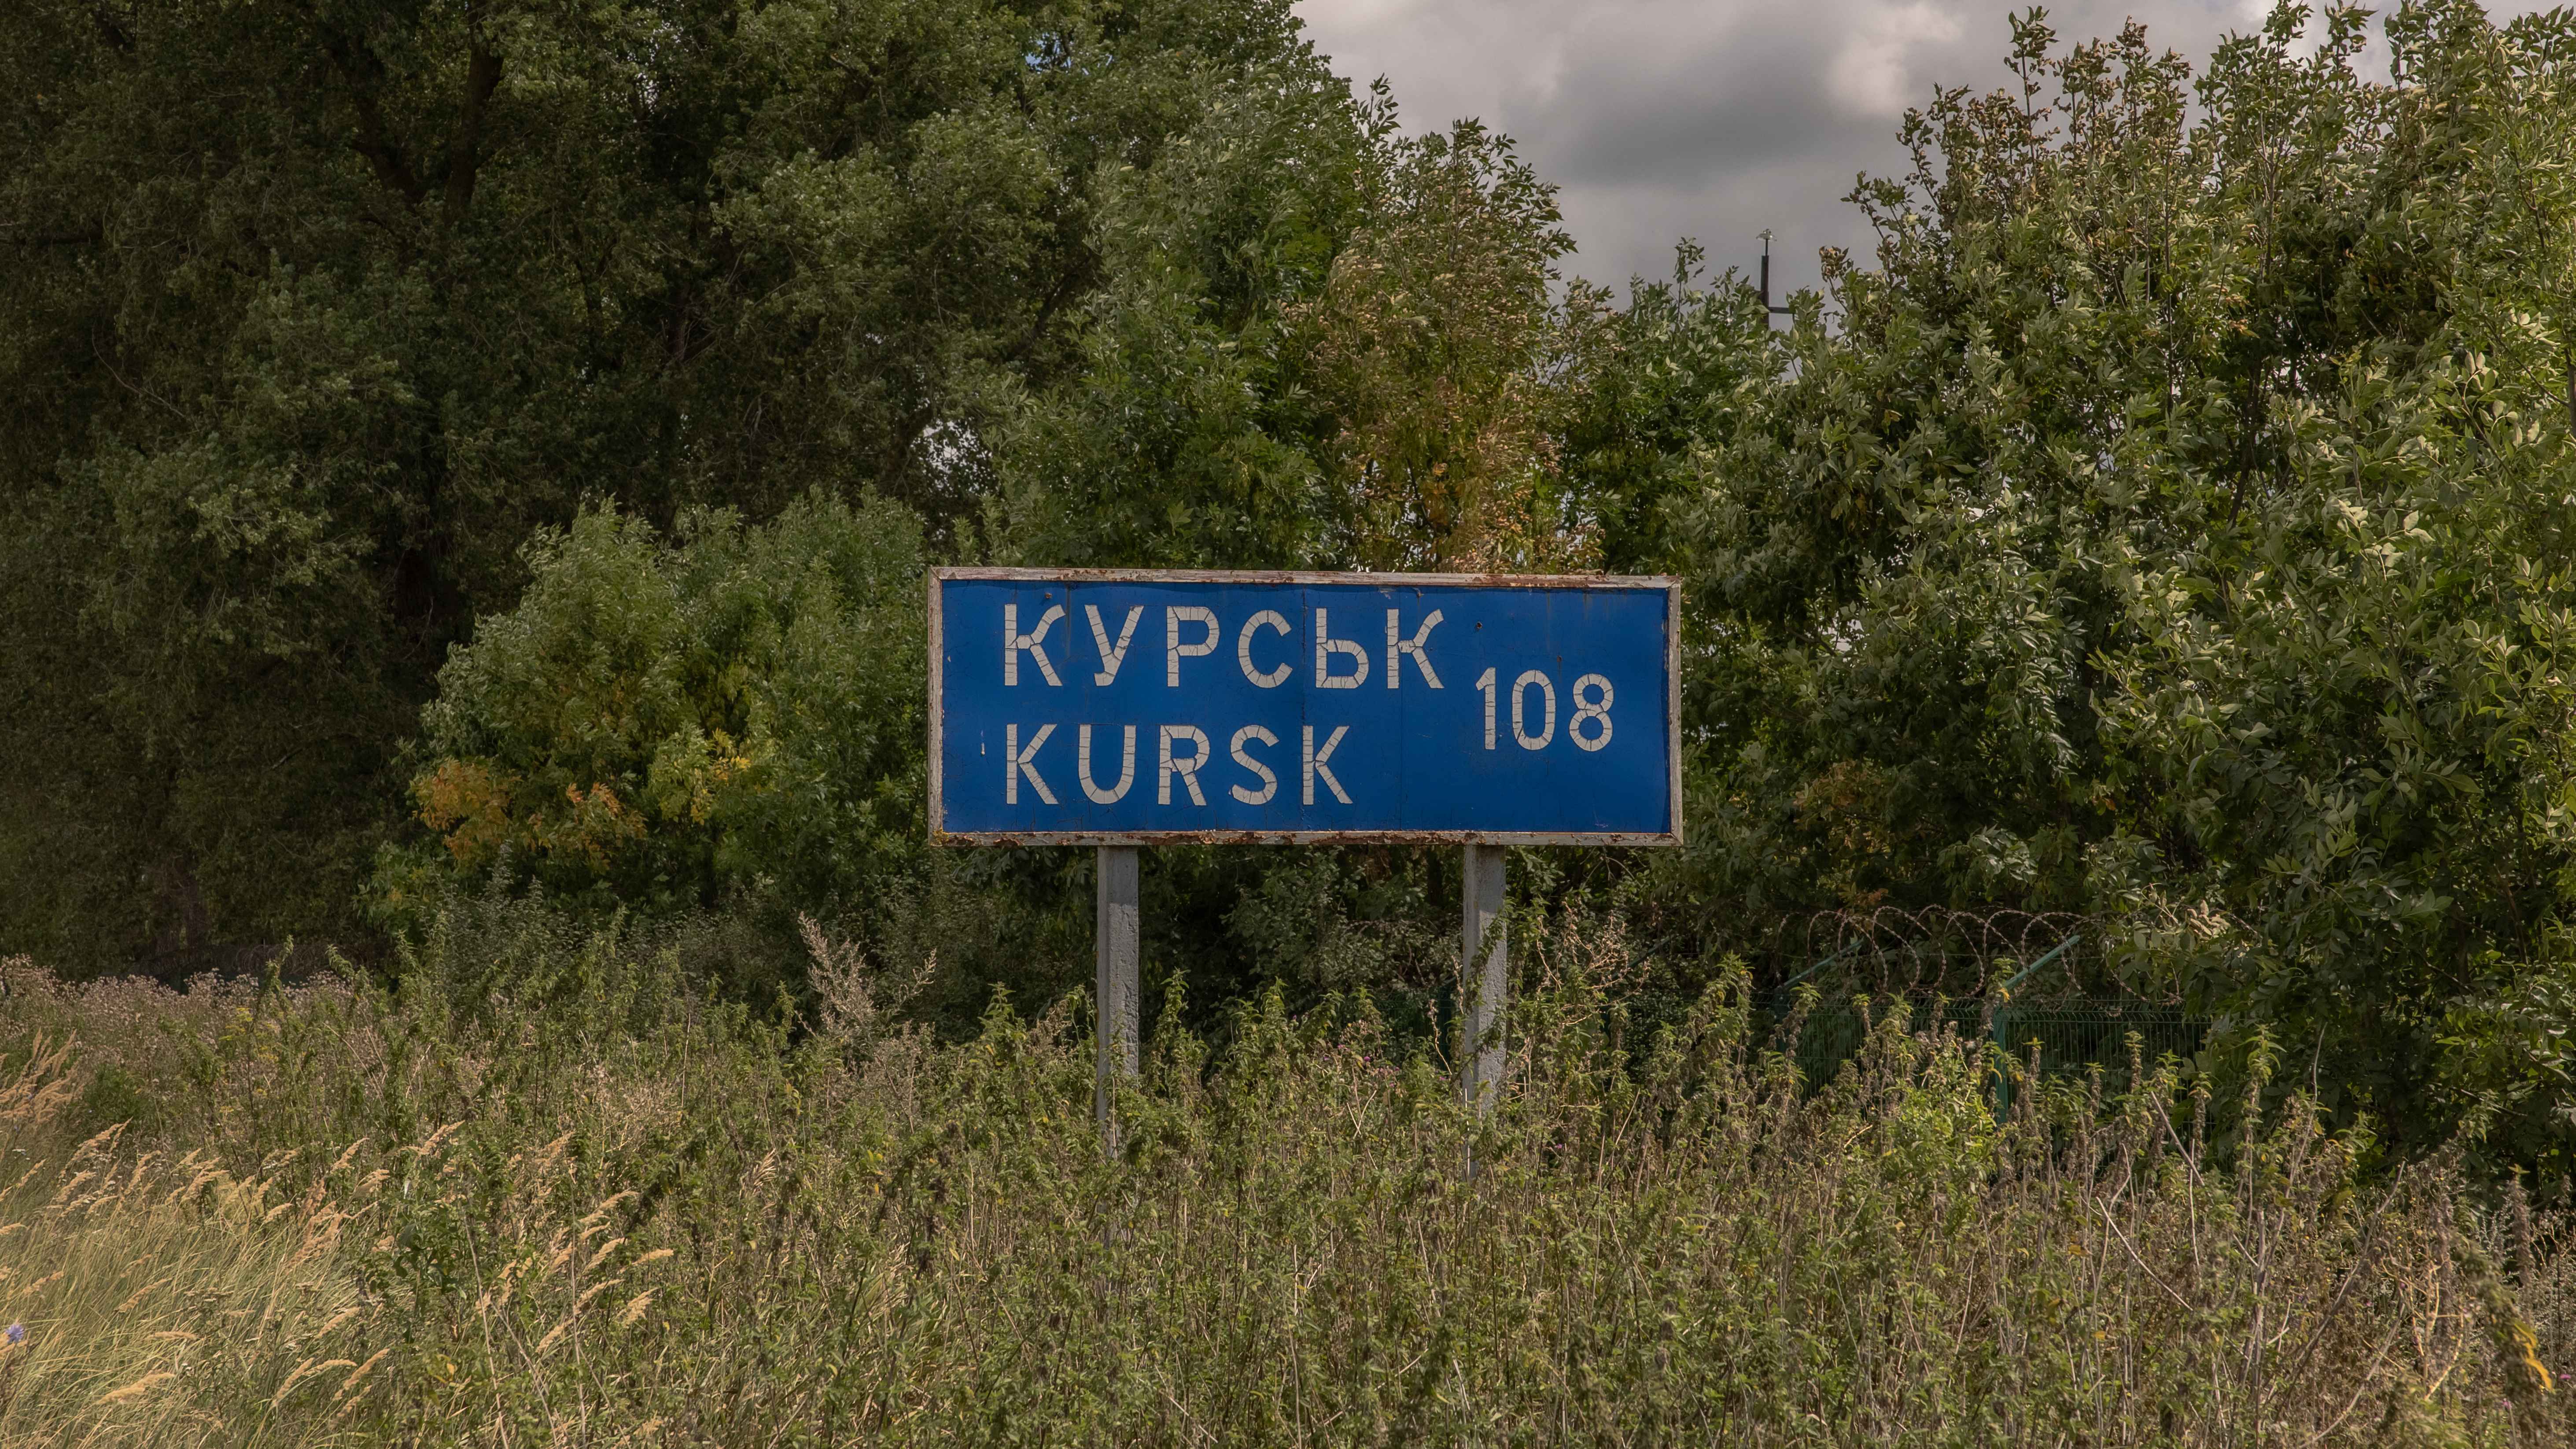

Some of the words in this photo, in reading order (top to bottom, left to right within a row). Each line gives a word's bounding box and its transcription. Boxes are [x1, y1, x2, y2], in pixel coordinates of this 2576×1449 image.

[1005, 604, 1444, 689] КУРСЬК
[1476, 668, 1614, 752] 108
[1006, 724, 1353, 806] KURSK
